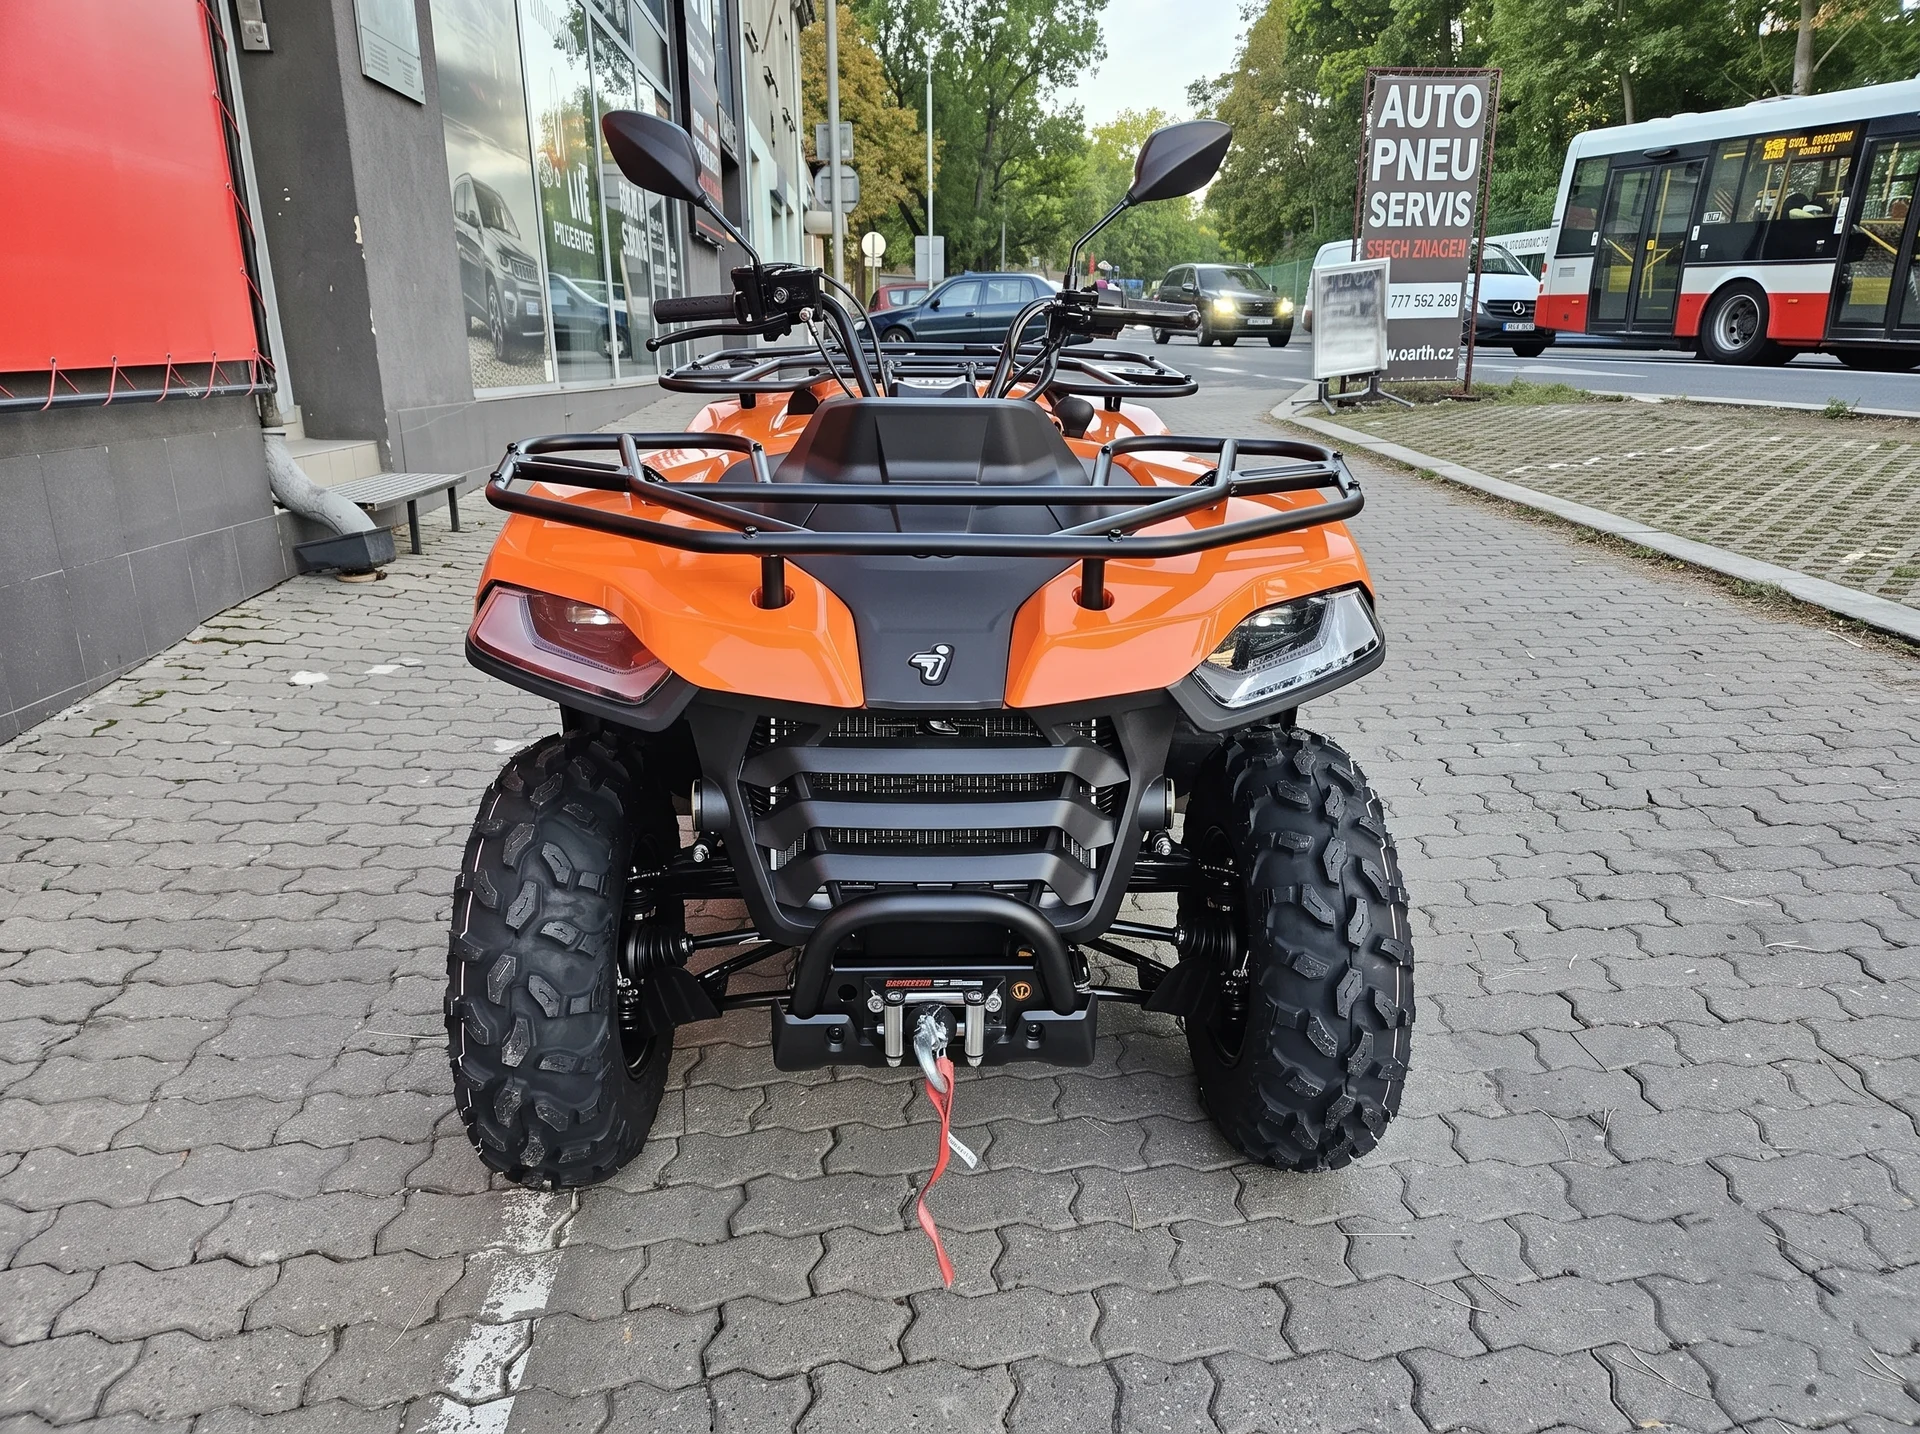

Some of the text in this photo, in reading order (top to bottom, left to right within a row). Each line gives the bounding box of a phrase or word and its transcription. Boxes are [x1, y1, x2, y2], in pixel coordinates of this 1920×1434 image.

[1377, 84, 1482, 128] AUTO
[1371, 138, 1478, 181] PNEU
[1368, 191, 1473, 228] SERVIS
[1391, 294, 1411, 308] 777
[1437, 293, 1458, 307] 289
